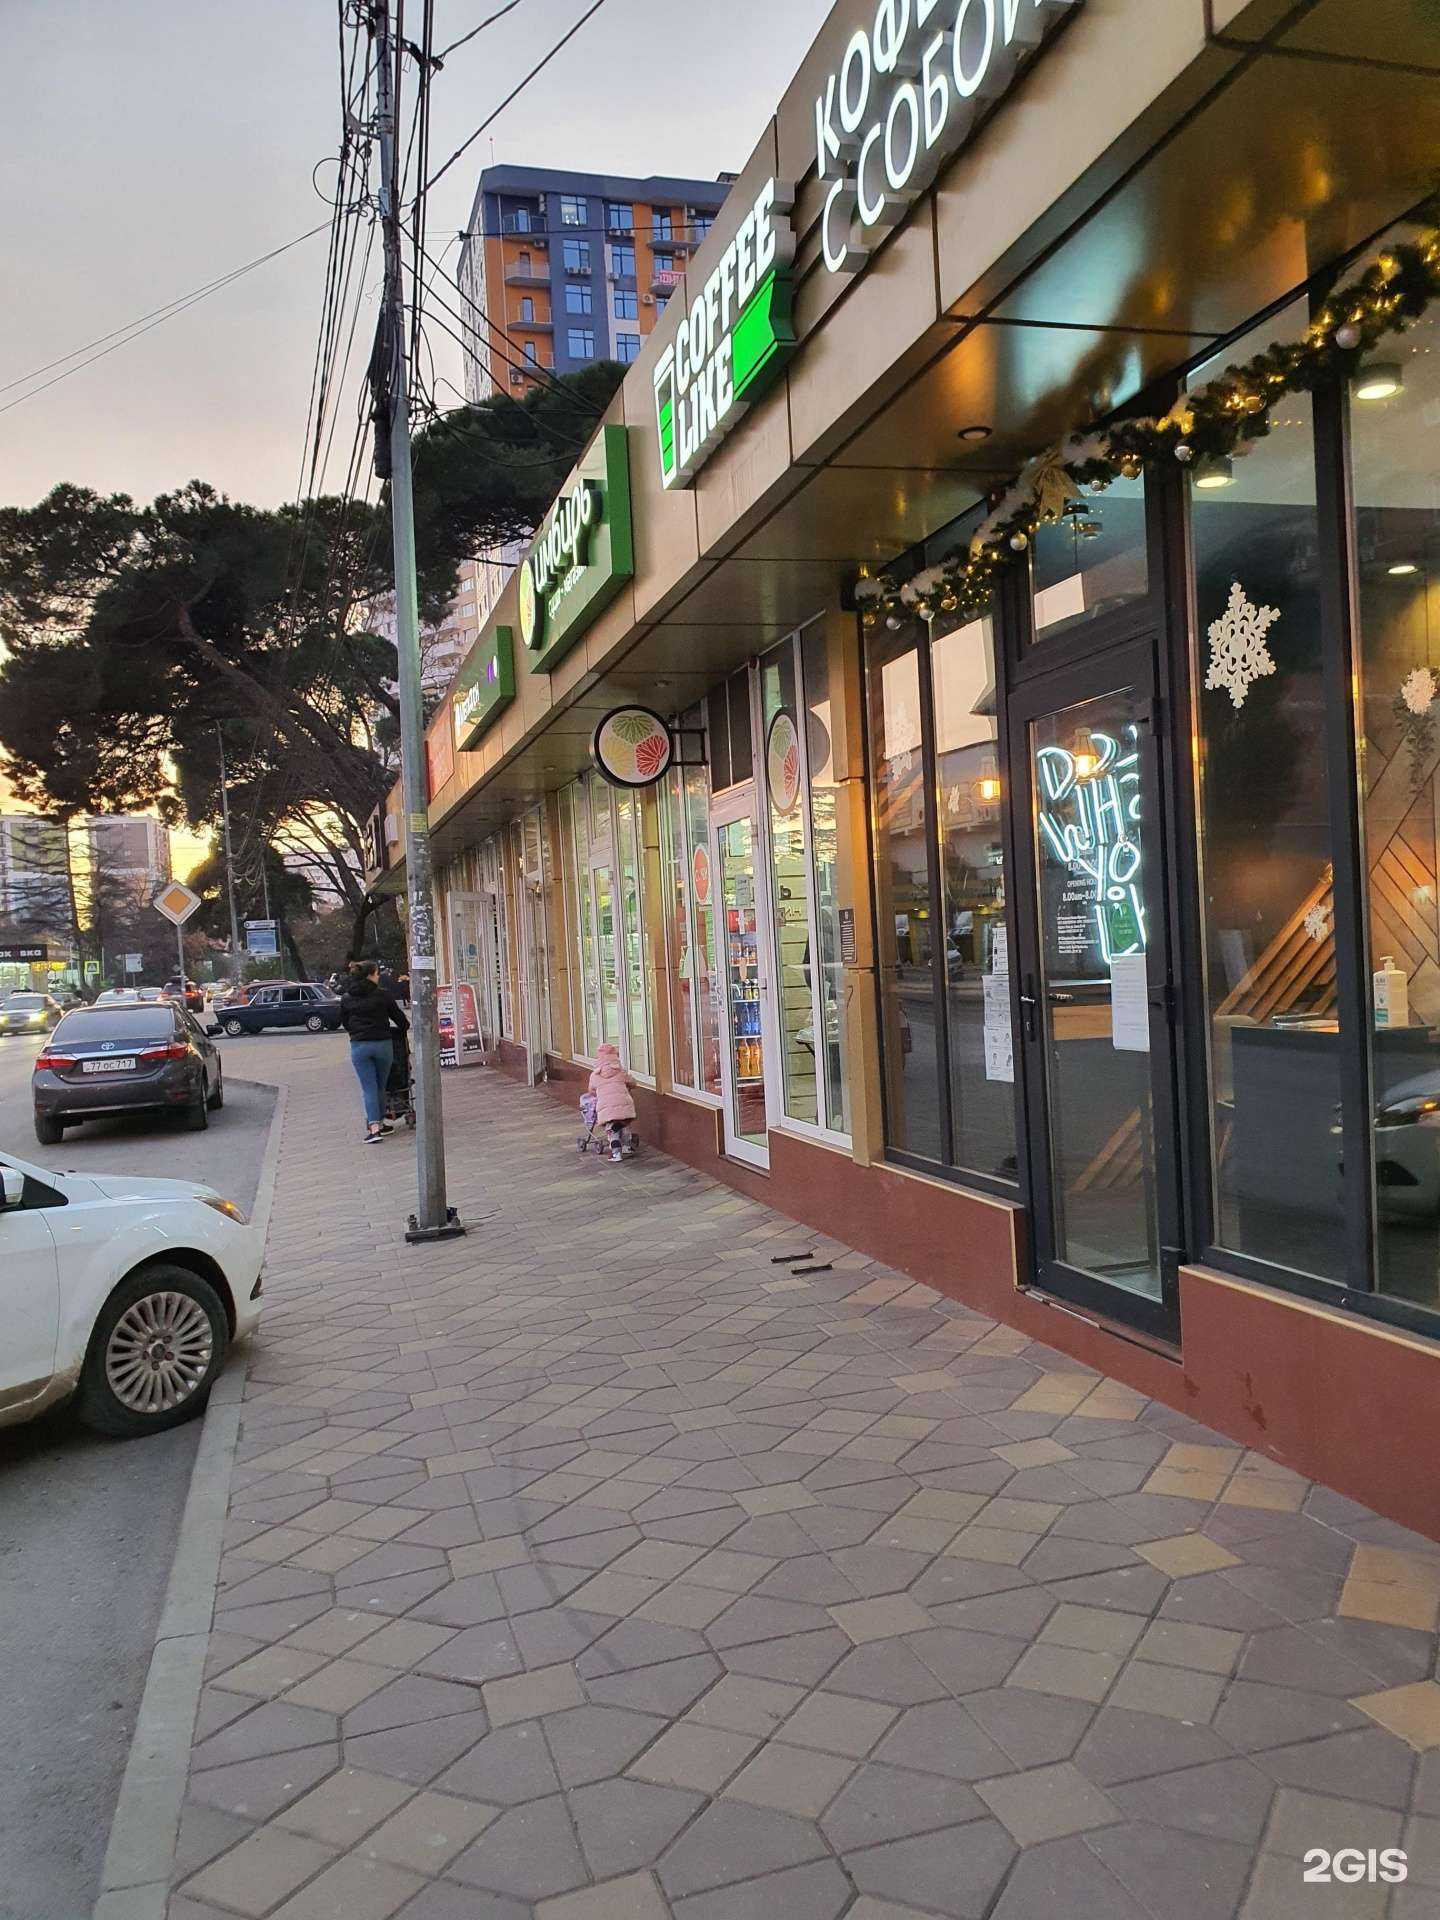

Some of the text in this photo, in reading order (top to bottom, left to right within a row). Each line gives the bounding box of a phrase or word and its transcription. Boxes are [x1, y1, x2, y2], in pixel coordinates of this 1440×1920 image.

[816, 0, 938, 180] КОФ
[822, 0, 1041, 273] С СОБО
[676, 177, 776, 395] COFFEE
[678, 333, 733, 469] LIKE
